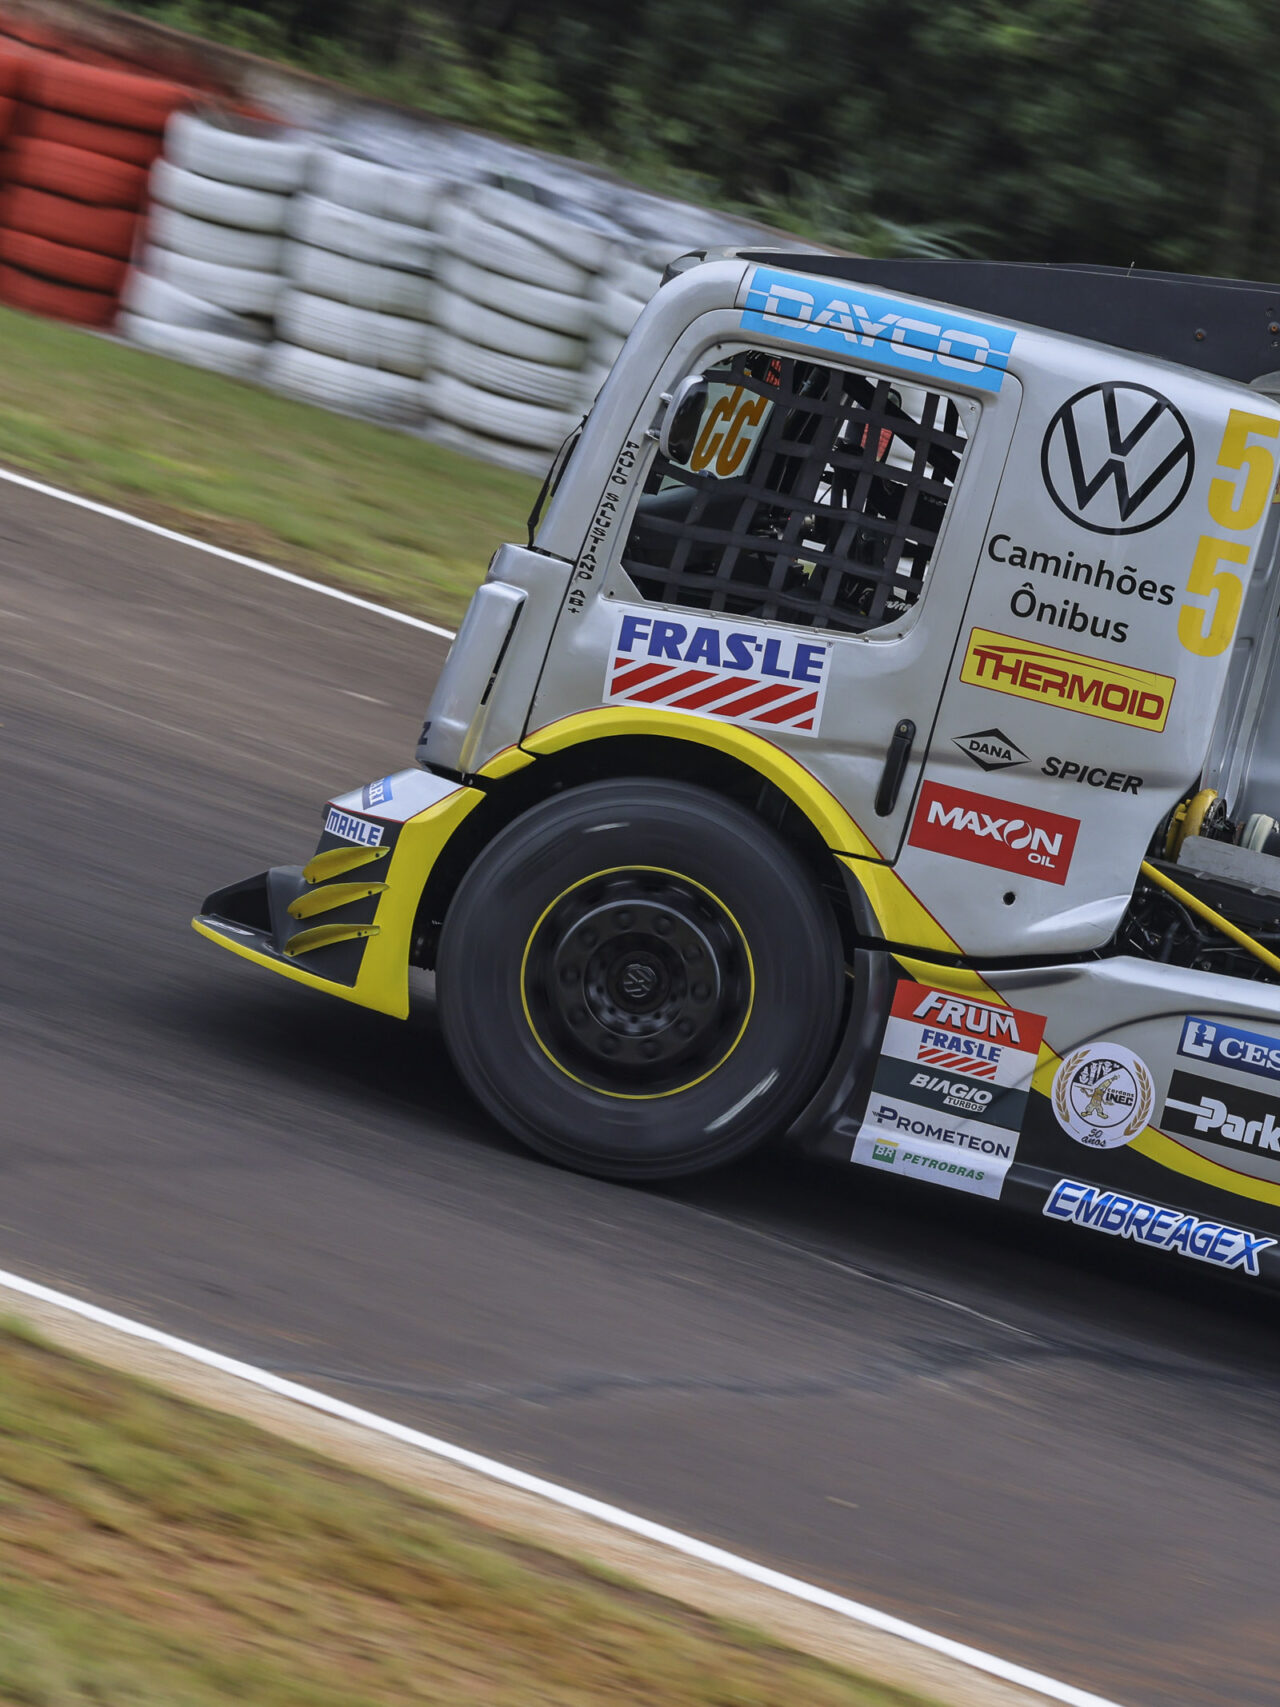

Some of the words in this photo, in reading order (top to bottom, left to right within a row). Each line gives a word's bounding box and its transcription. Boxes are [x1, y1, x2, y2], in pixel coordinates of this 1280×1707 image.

[762, 283, 990, 373] DAYCO
[612, 440, 640, 486] PAULO
[988, 534, 1176, 606] Caminhões
[1010, 582, 1129, 643] Ônibus
[972, 647, 1165, 720] THERMOID
[968, 739, 1013, 761] DANA
[1041, 757, 1144, 795] SPICER
[326, 810, 381, 847] MAHLE
[927, 800, 1063, 856] MAXON
[1027, 852, 1056, 869] OIL
[913, 991, 1021, 1044] FRUM
[909, 1073, 994, 1105] BIAGIO
[946, 1098, 985, 1113] TURBOS
[1105, 1092, 1134, 1107] INEC
[902, 1151, 985, 1182] PETROBRAS
[1045, 1180, 1276, 1272] EMBREAGEX
